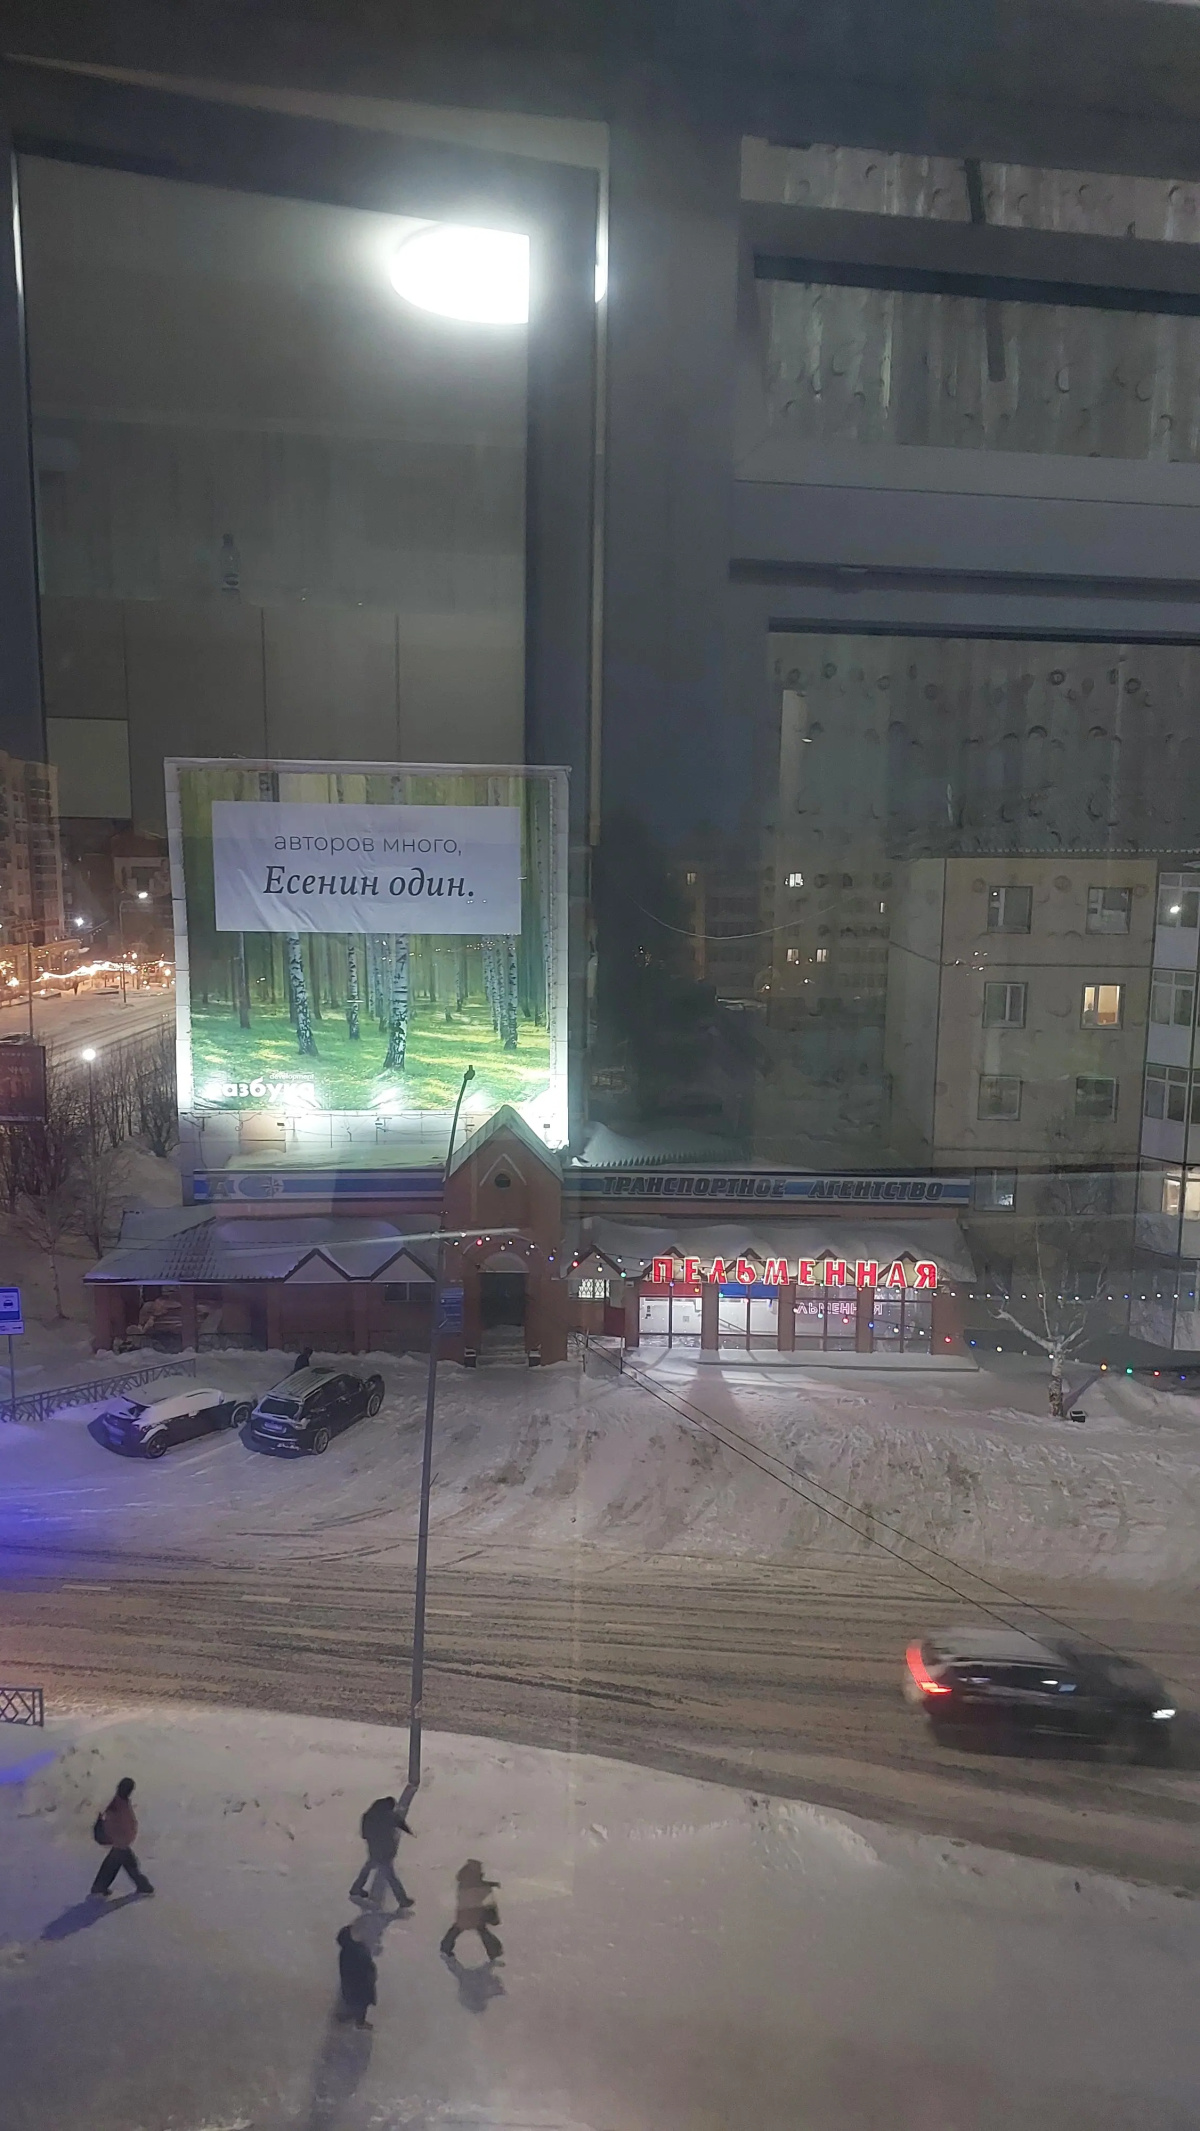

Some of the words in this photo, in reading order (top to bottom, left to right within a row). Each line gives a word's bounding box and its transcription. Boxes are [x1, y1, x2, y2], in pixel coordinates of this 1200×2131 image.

[275, 834, 375, 856] авторов
[383, 836, 463, 857] много,
[263, 866, 380, 897] Есенин
[389, 867, 475, 898] один.
[602, 1176, 786, 1198] ТРАНСПОРТНОЕ
[809, 1179, 945, 1200] АГЕНТСТВО
[652, 1256, 938, 1289] ПЕЛЬМЕННАЯ
